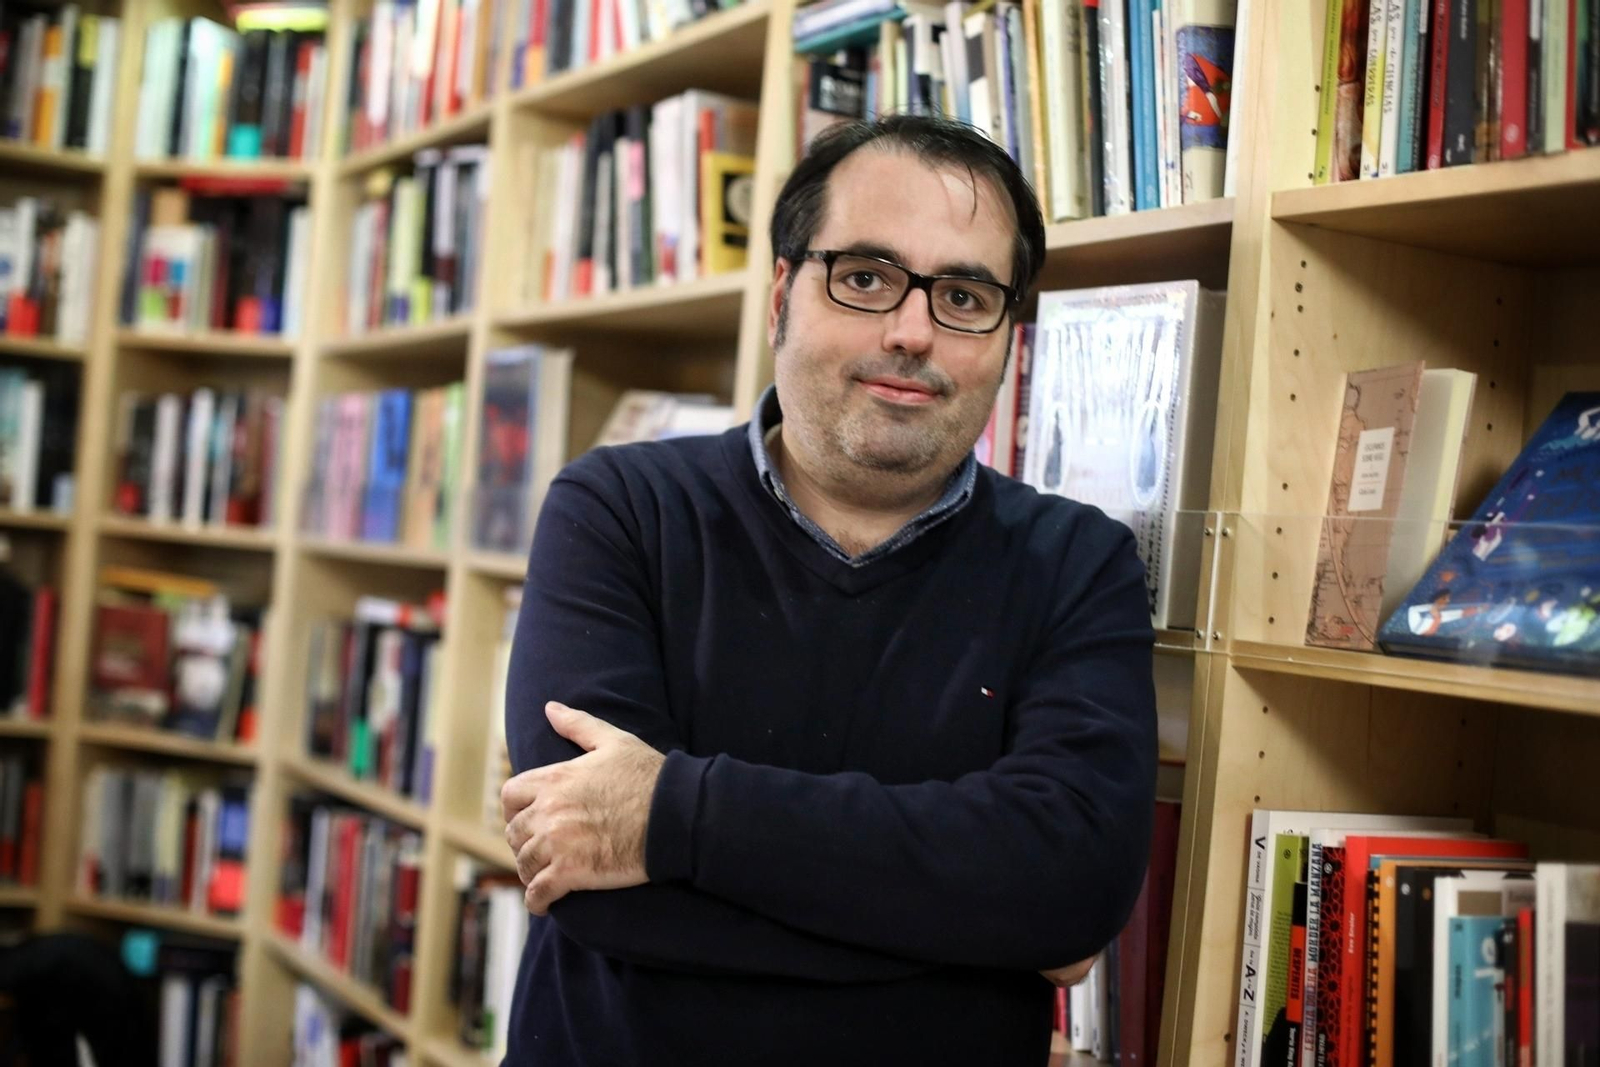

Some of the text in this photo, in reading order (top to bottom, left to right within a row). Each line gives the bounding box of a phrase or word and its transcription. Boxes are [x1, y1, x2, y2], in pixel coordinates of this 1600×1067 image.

[1255, 836, 1266, 850] V
[1304, 843, 1322, 1052] LETICIA DOLERA MORDER LA MANZANA
[1245, 964, 1256, 978] A
[1290, 947, 1302, 1000] DESPENTES
[1244, 988, 1254, 1001] Z
